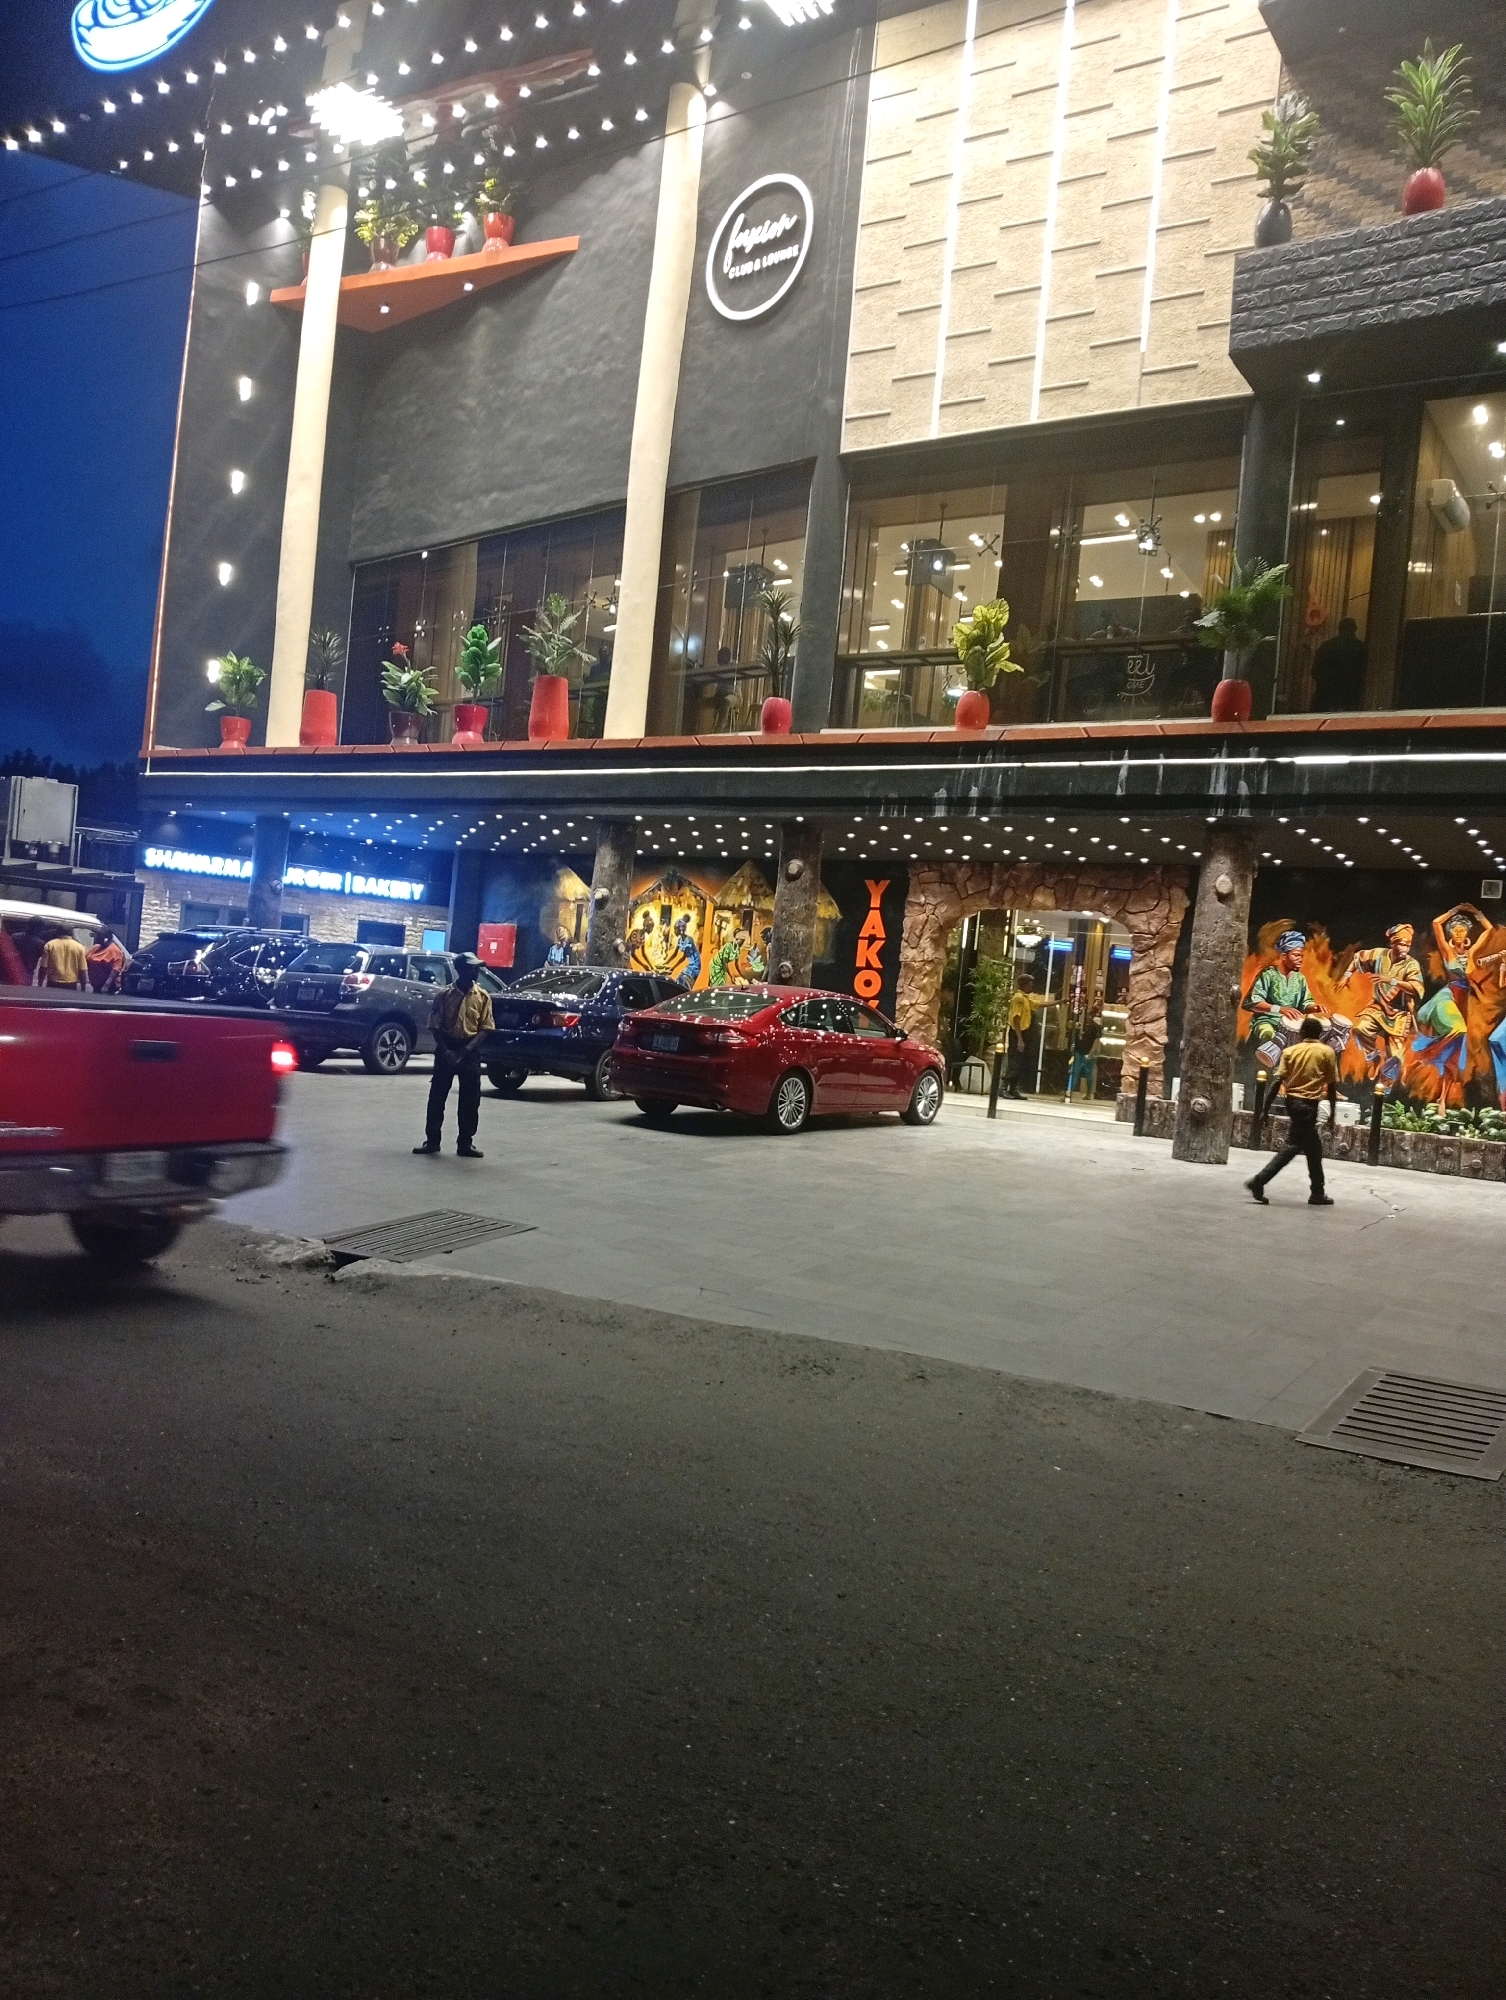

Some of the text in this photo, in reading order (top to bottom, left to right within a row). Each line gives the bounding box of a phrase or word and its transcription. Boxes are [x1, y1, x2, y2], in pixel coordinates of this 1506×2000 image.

[728, 244, 800, 279] CLUB & LOUNGE
[351, 875, 425, 900] BAKERY
[853, 879, 891, 1010] YAKO
